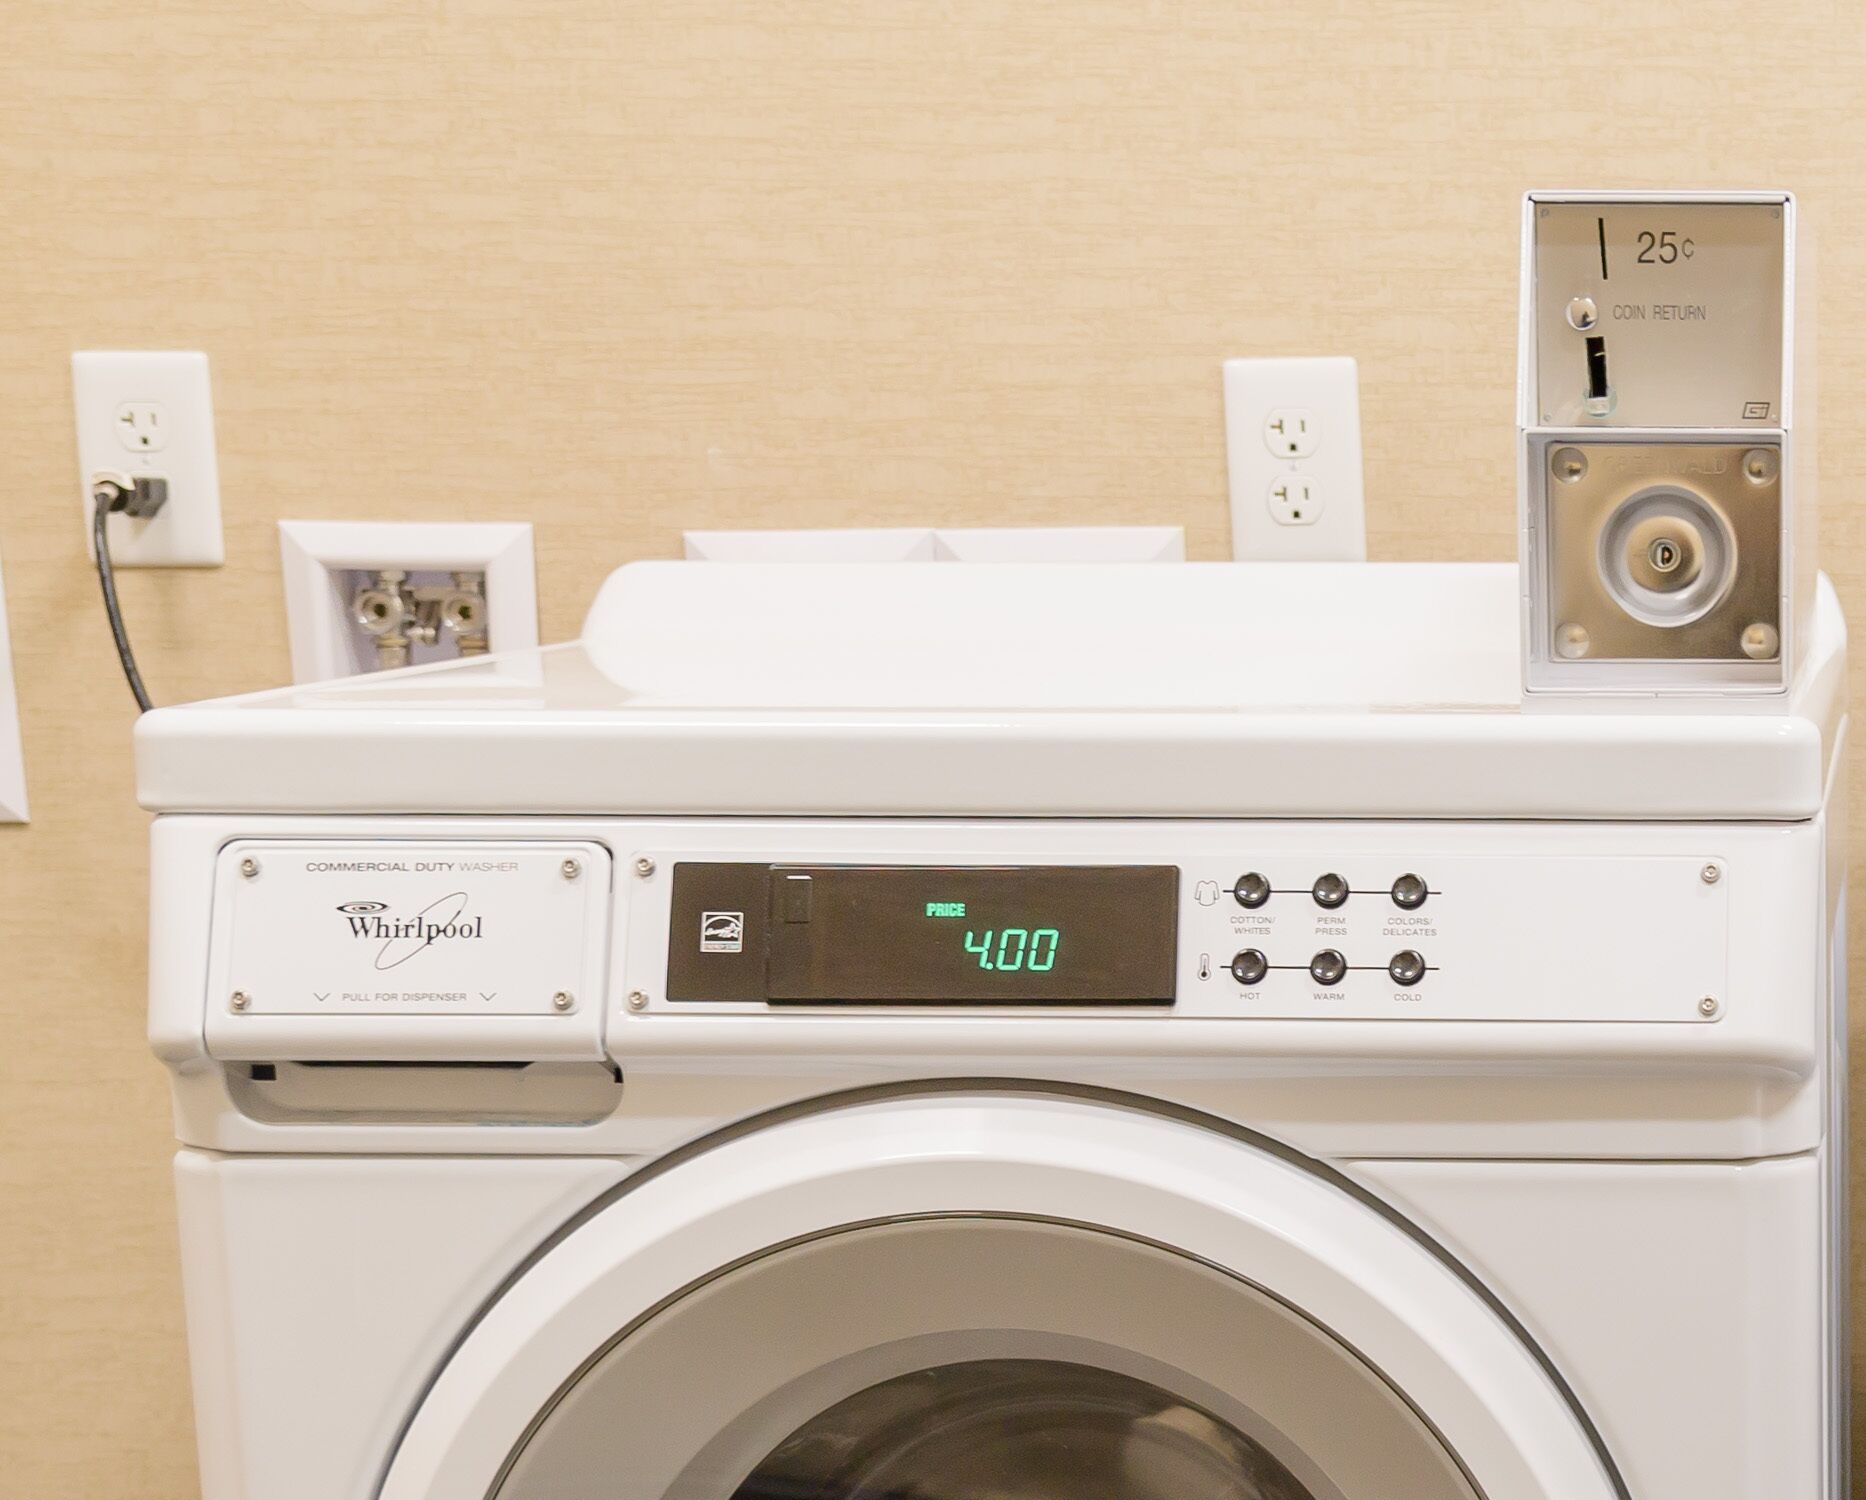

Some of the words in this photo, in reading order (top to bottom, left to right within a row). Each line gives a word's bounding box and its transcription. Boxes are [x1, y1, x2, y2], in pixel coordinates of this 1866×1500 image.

[1637, 230, 1695, 264] 25¢
[1613, 304, 1646, 320] COIN
[1653, 304, 1706, 321] RETURN
[306, 862, 410, 872] COMMERCIAL
[414, 862, 456, 872] DUTY
[459, 862, 519, 872] WASHER
[926, 902, 965, 917] PRICE
[1229, 915, 1277, 925] COTTON/
[1316, 916, 1346, 925] PERM
[1387, 916, 1434, 926] COLORS/
[346, 916, 483, 945] Whirlpool
[1234, 926, 1271, 936] WHITES
[1314, 926, 1348, 936] PRESS
[1382, 927, 1438, 937] DELICATES
[965, 928, 1059, 971] 4.00
[342, 992, 371, 1002] PULL
[374, 992, 399, 1002] FOR
[402, 992, 467, 1002] DISPENSER
[1239, 991, 1261, 1001] HOT
[1312, 992, 1345, 1001] WARM
[1393, 992, 1422, 1002] COLD
